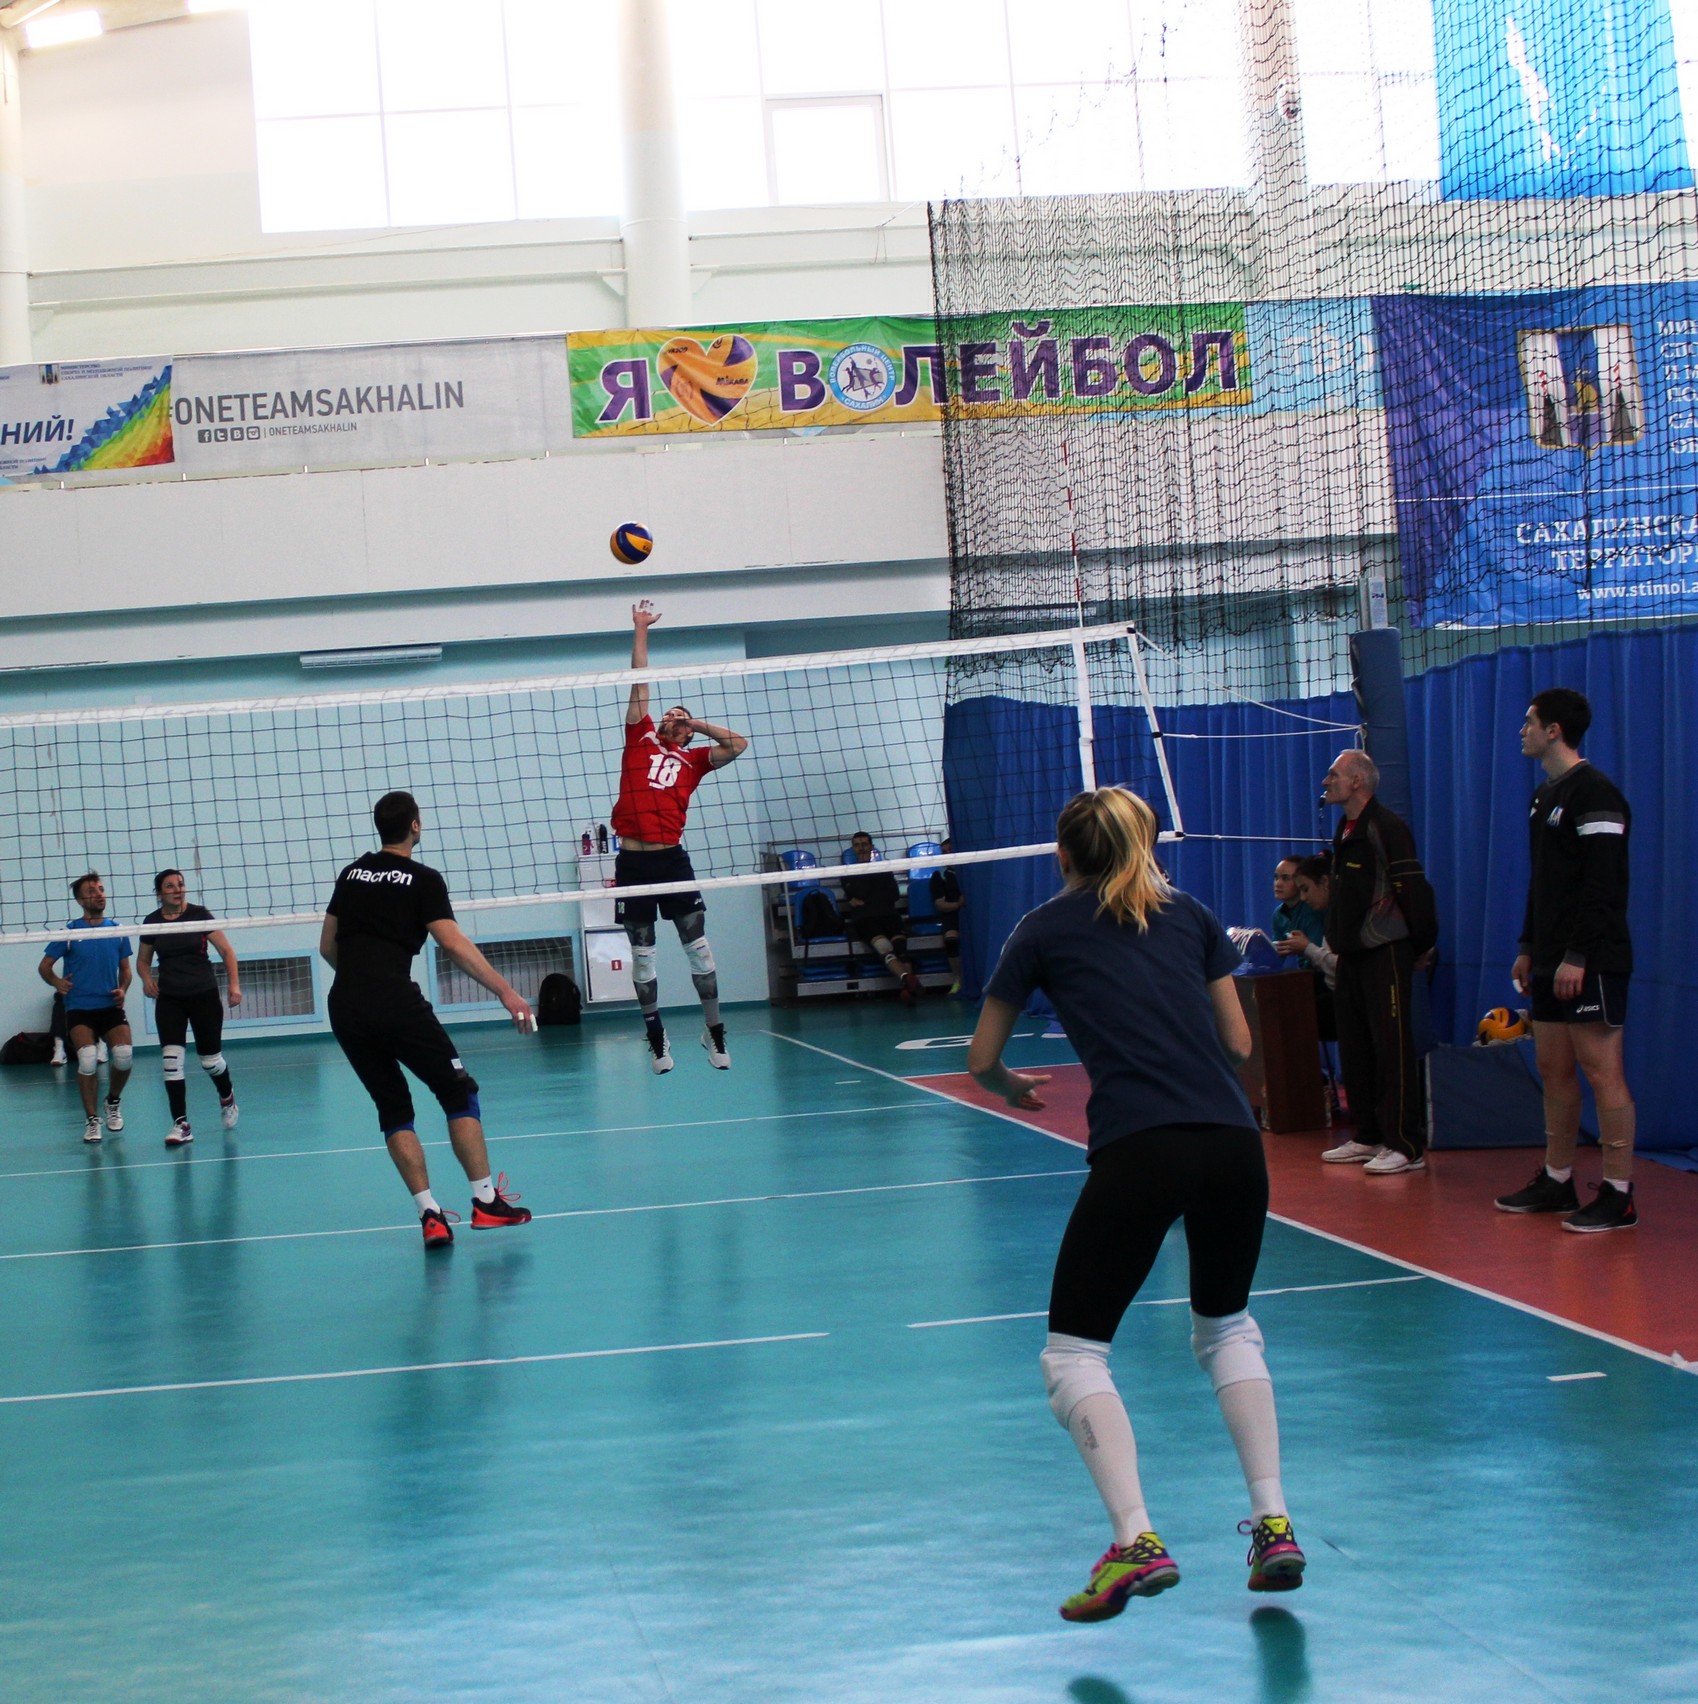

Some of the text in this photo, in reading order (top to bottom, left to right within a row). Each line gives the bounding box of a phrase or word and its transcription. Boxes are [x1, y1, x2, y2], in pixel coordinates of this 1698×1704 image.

[597, 359, 651, 422] Я
[1, 415, 74, 445] НИЙ!
[269, 422, 357, 436] ONETEAMSAKHALIN
[1552, 541, 1698, 570] ТЕРРИТОР
[647, 753, 682, 787] 18
[346, 868, 413, 885] macron
